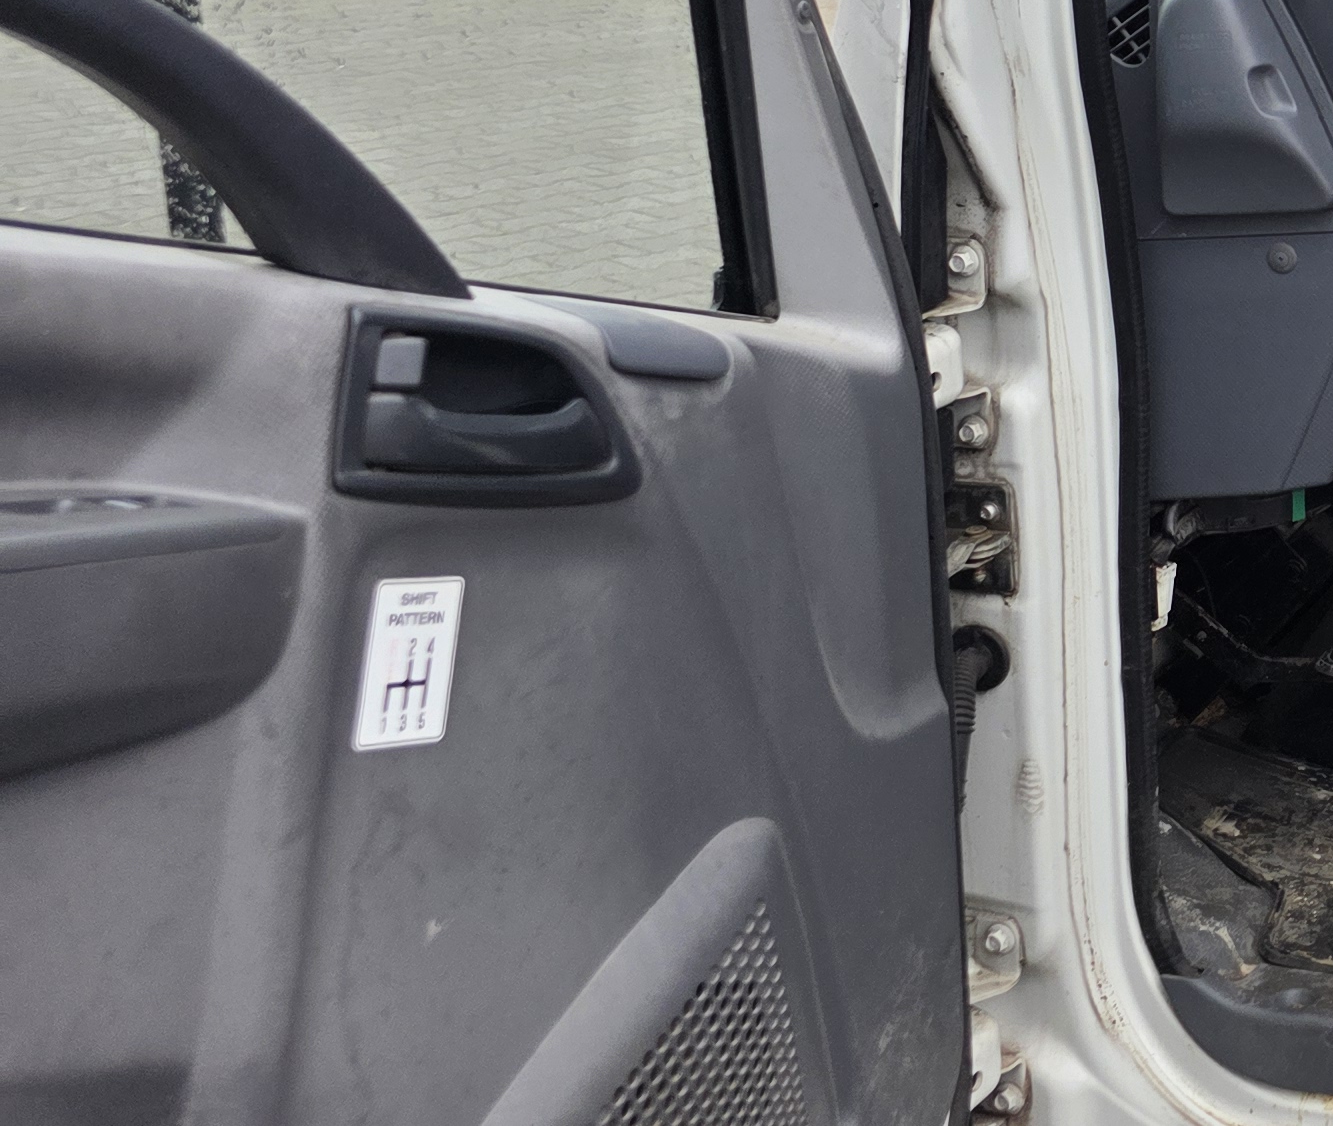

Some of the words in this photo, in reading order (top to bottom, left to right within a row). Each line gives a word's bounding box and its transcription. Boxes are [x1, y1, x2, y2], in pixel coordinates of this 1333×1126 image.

[401, 591, 438, 606] SHIFT
[389, 611, 445, 626] PATTERN
[408, 638, 417, 656] 2
[427, 637, 436, 654] 4
[380, 716, 388, 735] 1
[399, 713, 408, 733] 3
[418, 711, 427, 730] 5
